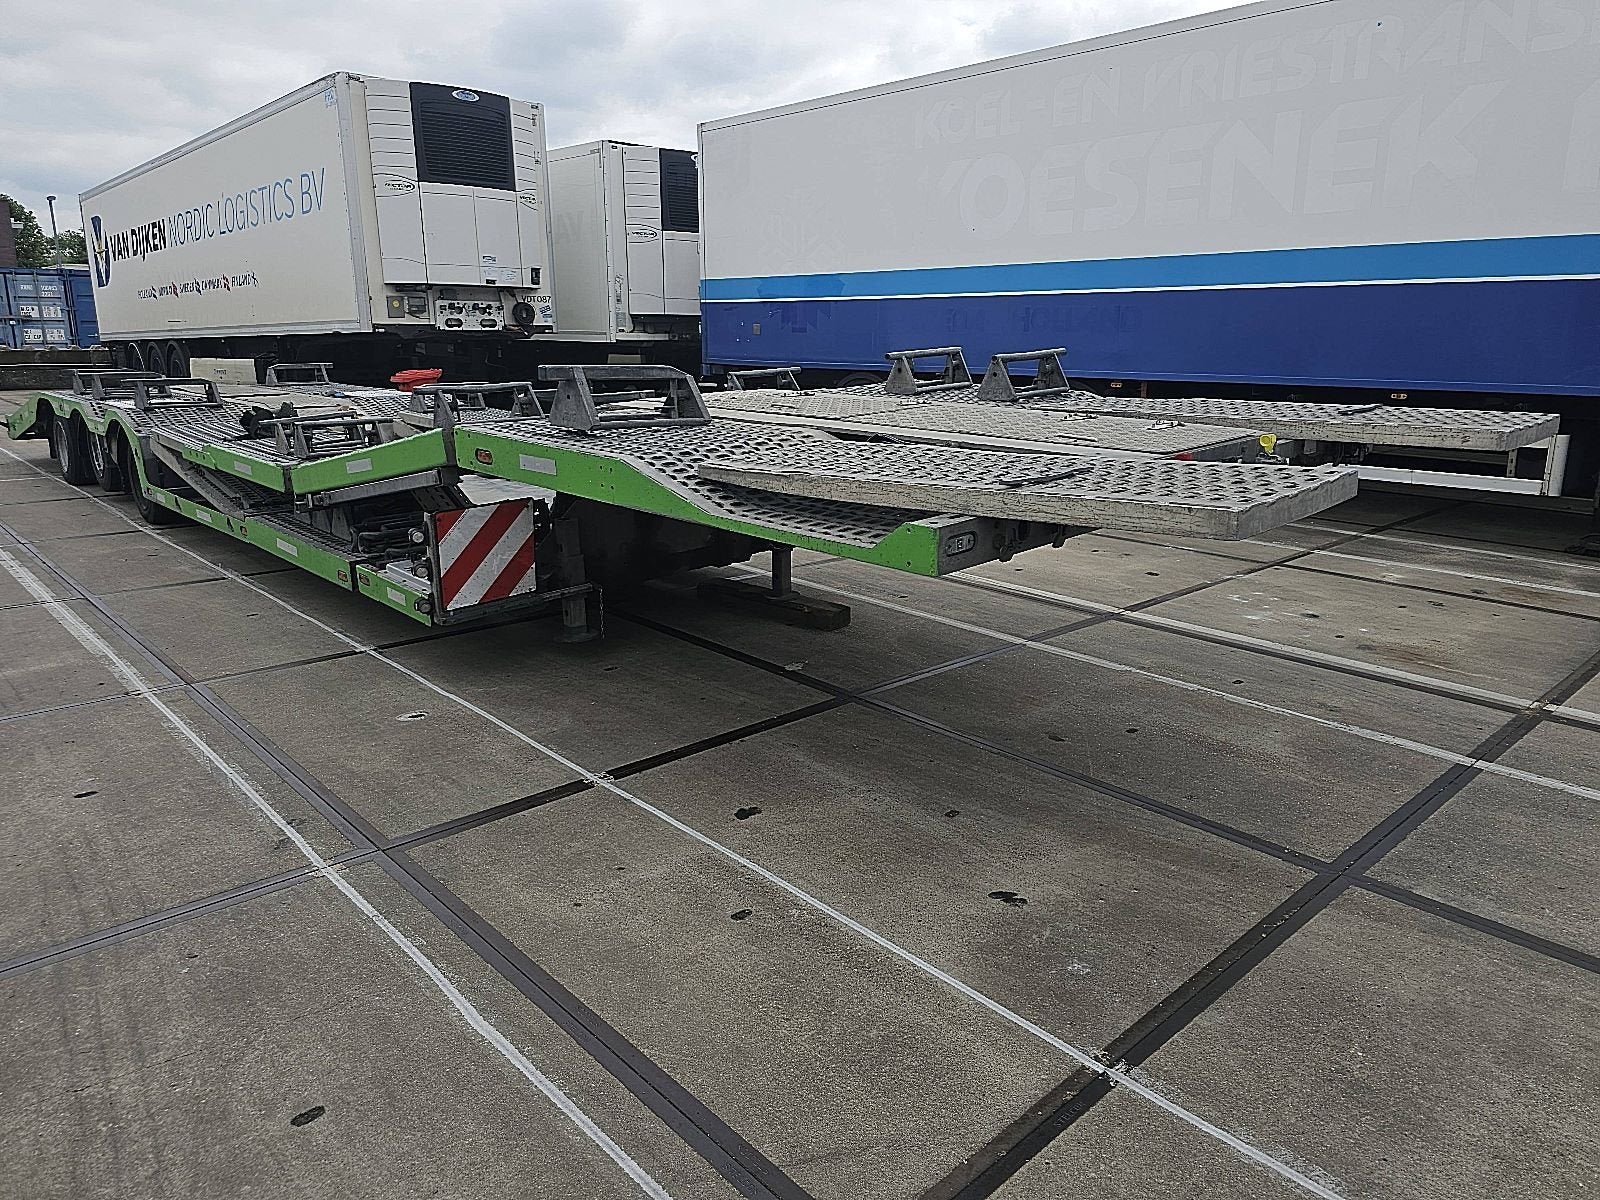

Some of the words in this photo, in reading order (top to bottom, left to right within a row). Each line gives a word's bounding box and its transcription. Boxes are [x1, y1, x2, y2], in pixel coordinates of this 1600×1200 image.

[1142, 0, 1600, 112] VRIESTRANS
[110, 231, 130, 261] VAN
[131, 219, 167, 261] DIJKEN
[169, 204, 214, 247] NORDIC
[217, 179, 294, 234] LOGISTICS
[300, 168, 324, 214] BV
